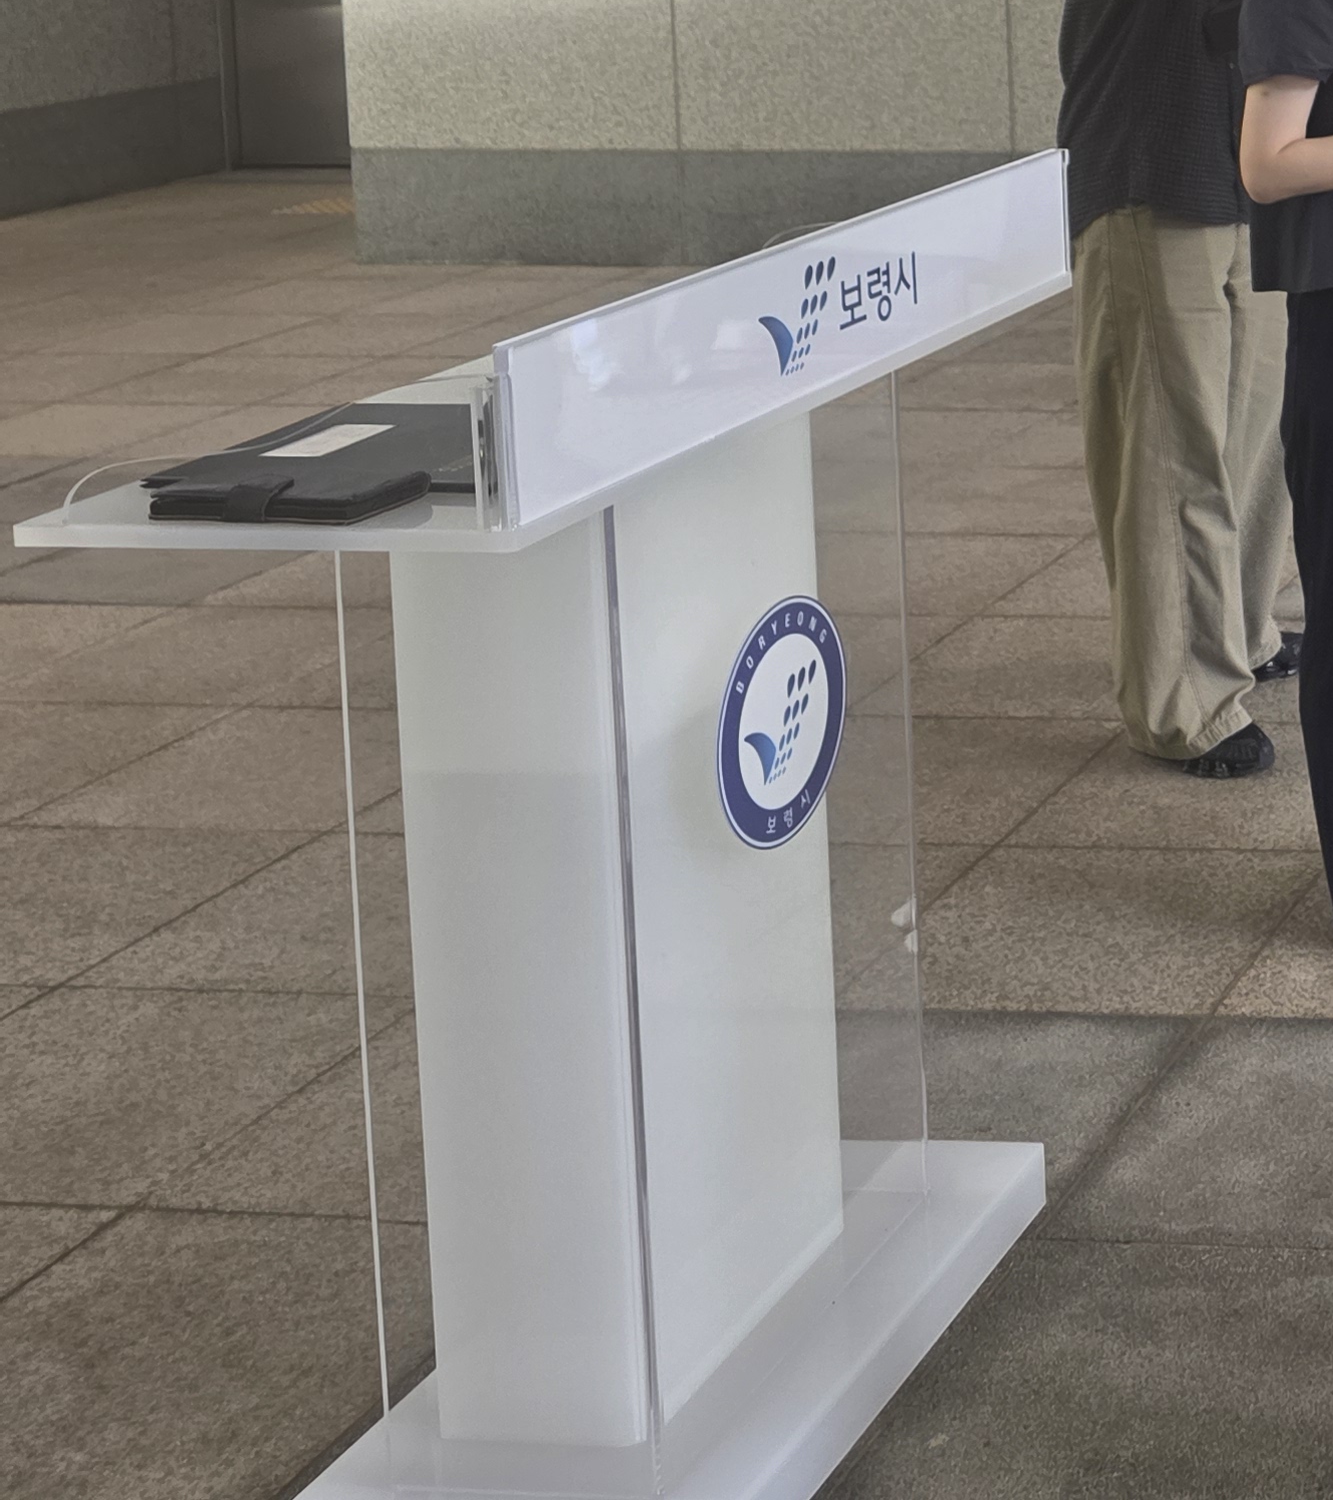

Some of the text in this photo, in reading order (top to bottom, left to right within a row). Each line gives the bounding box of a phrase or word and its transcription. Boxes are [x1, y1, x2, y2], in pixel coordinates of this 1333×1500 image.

[839, 251, 918, 330] 보령시
[735, 610, 828, 695] BORYEONG
[765, 788, 812, 835] 보령시
